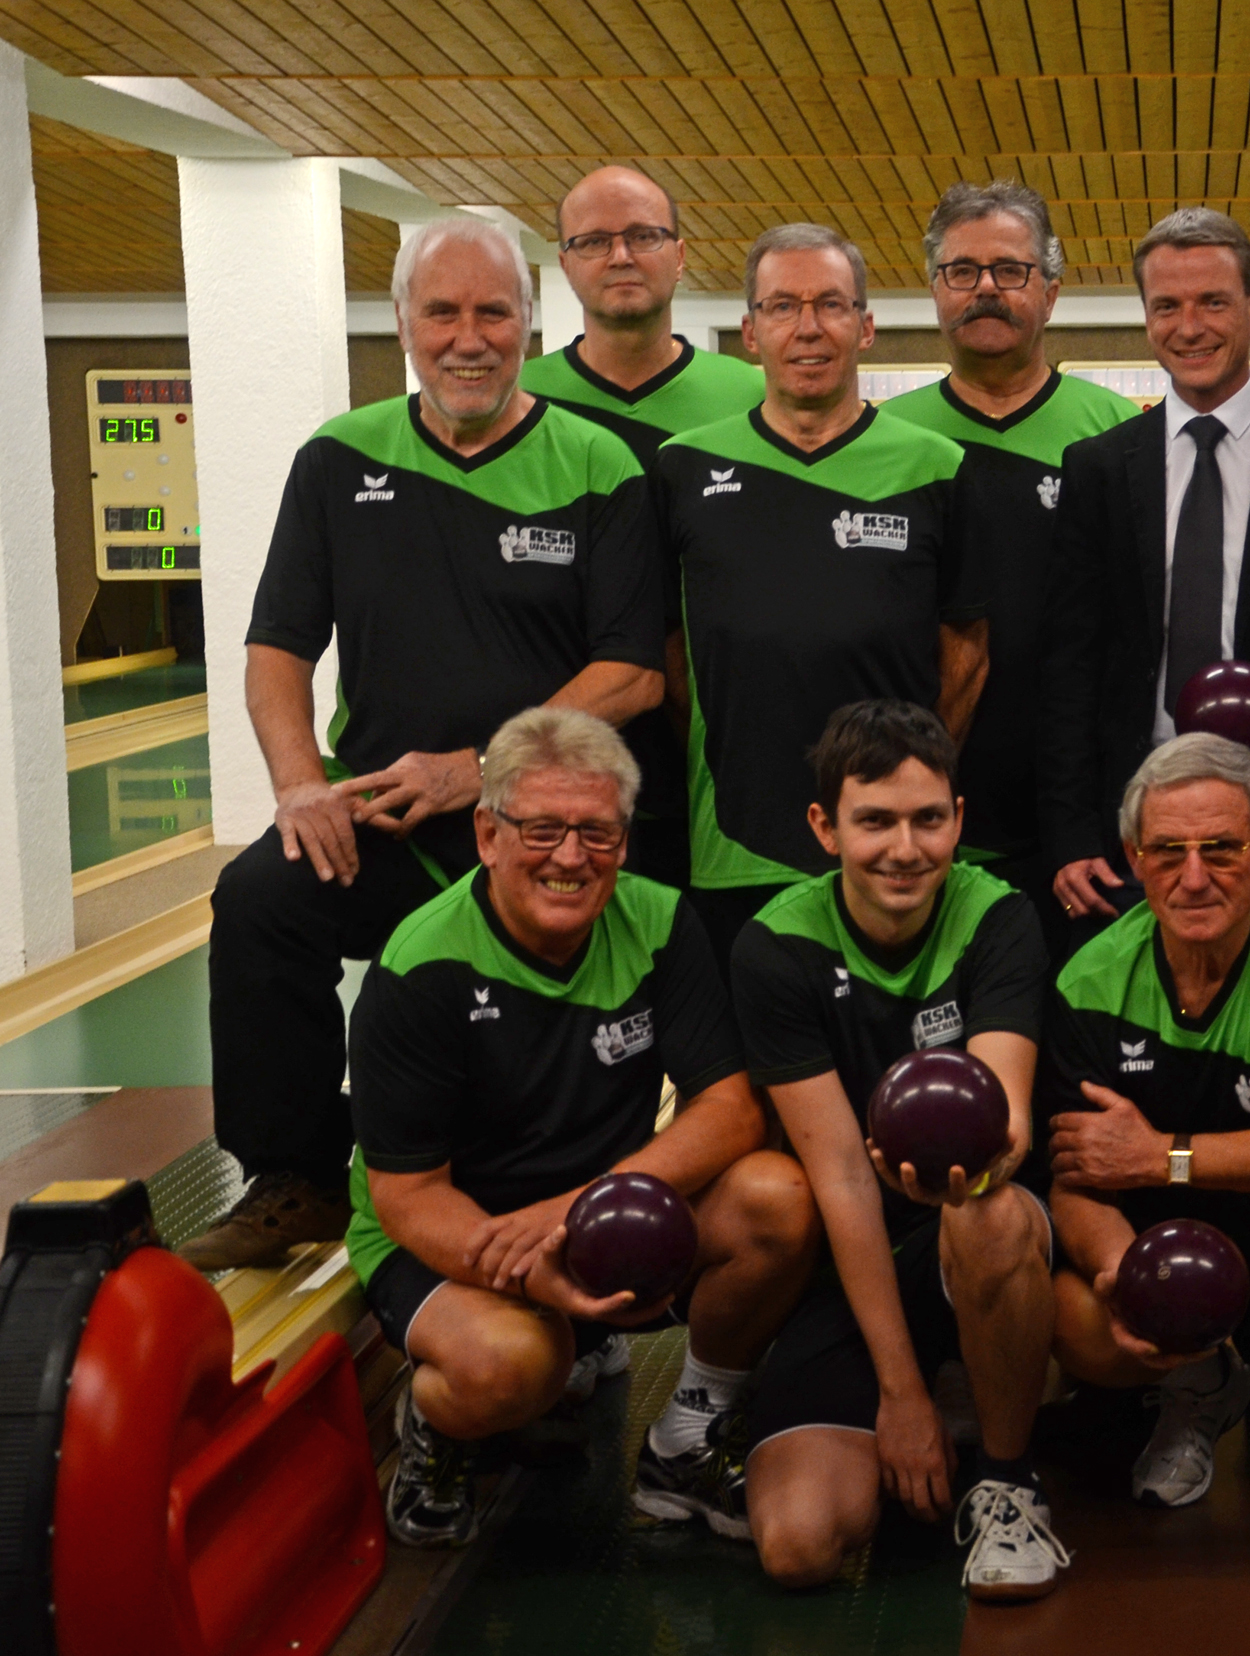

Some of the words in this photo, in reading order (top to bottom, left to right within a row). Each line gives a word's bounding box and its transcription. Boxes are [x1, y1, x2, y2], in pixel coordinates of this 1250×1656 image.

[354, 489, 395, 503] erima
[703, 481, 742, 497] erima
[863, 515, 907, 531] KSK
[529, 529, 574, 546] KSK
[920, 1004, 958, 1027] KSK
[619, 1014, 650, 1036] KS
